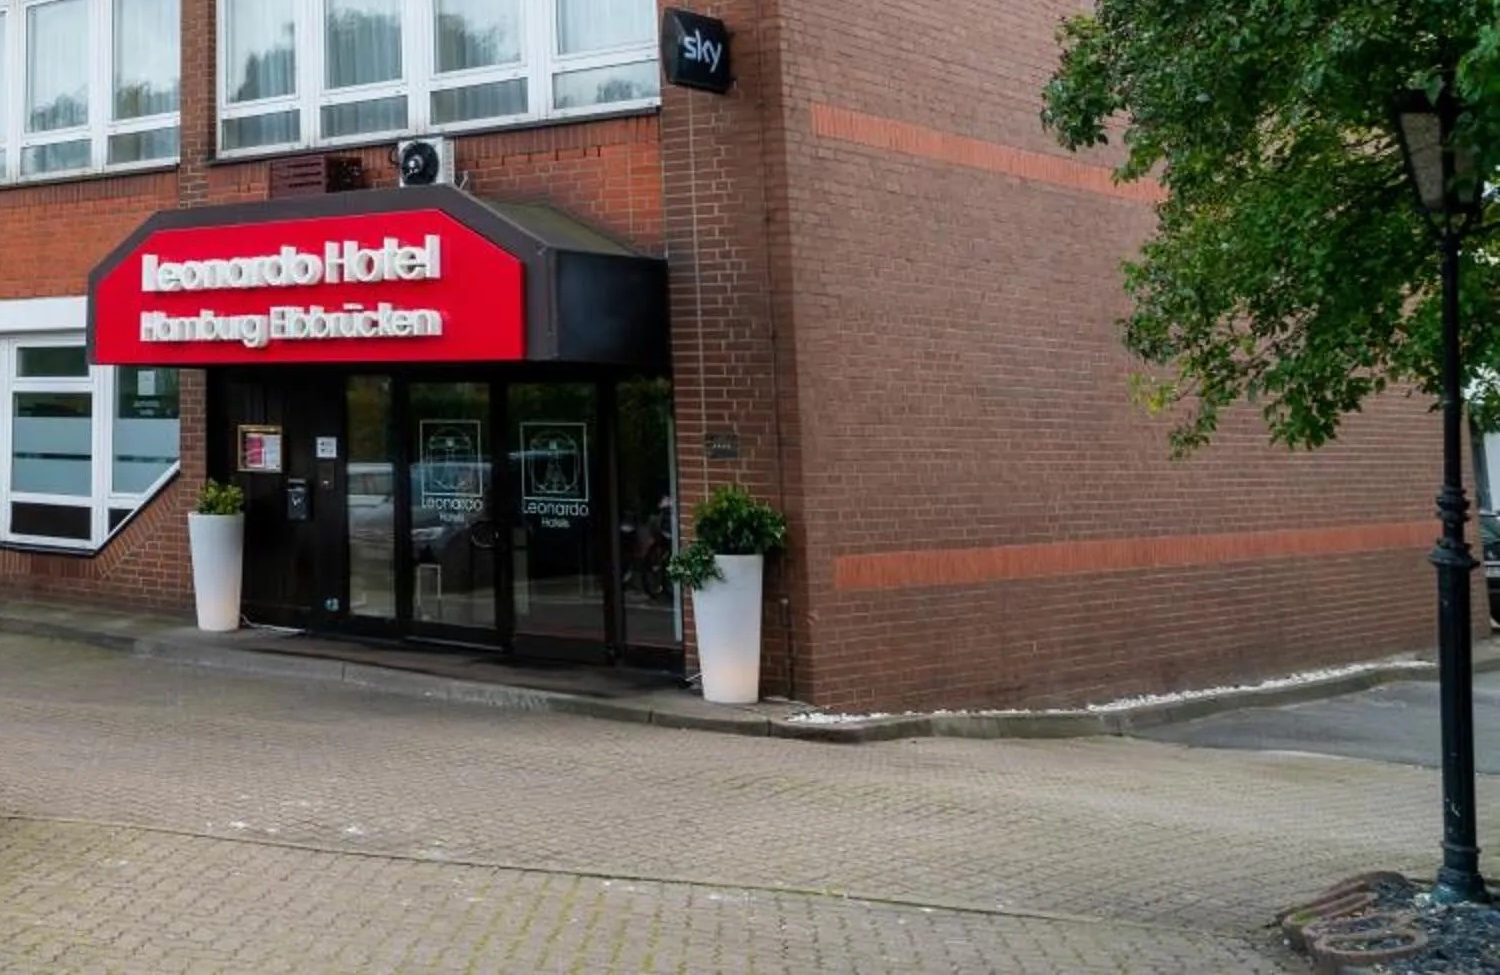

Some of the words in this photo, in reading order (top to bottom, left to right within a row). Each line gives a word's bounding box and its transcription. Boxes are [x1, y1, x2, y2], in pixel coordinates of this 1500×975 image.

[683, 28, 722, 73] sky
[141, 244, 323, 293] Leonardo
[324, 234, 441, 285] Hotel
[140, 308, 268, 349] Hamburg
[269, 302, 443, 341] Elbbrücken
[523, 501, 589, 517] Leonardo
